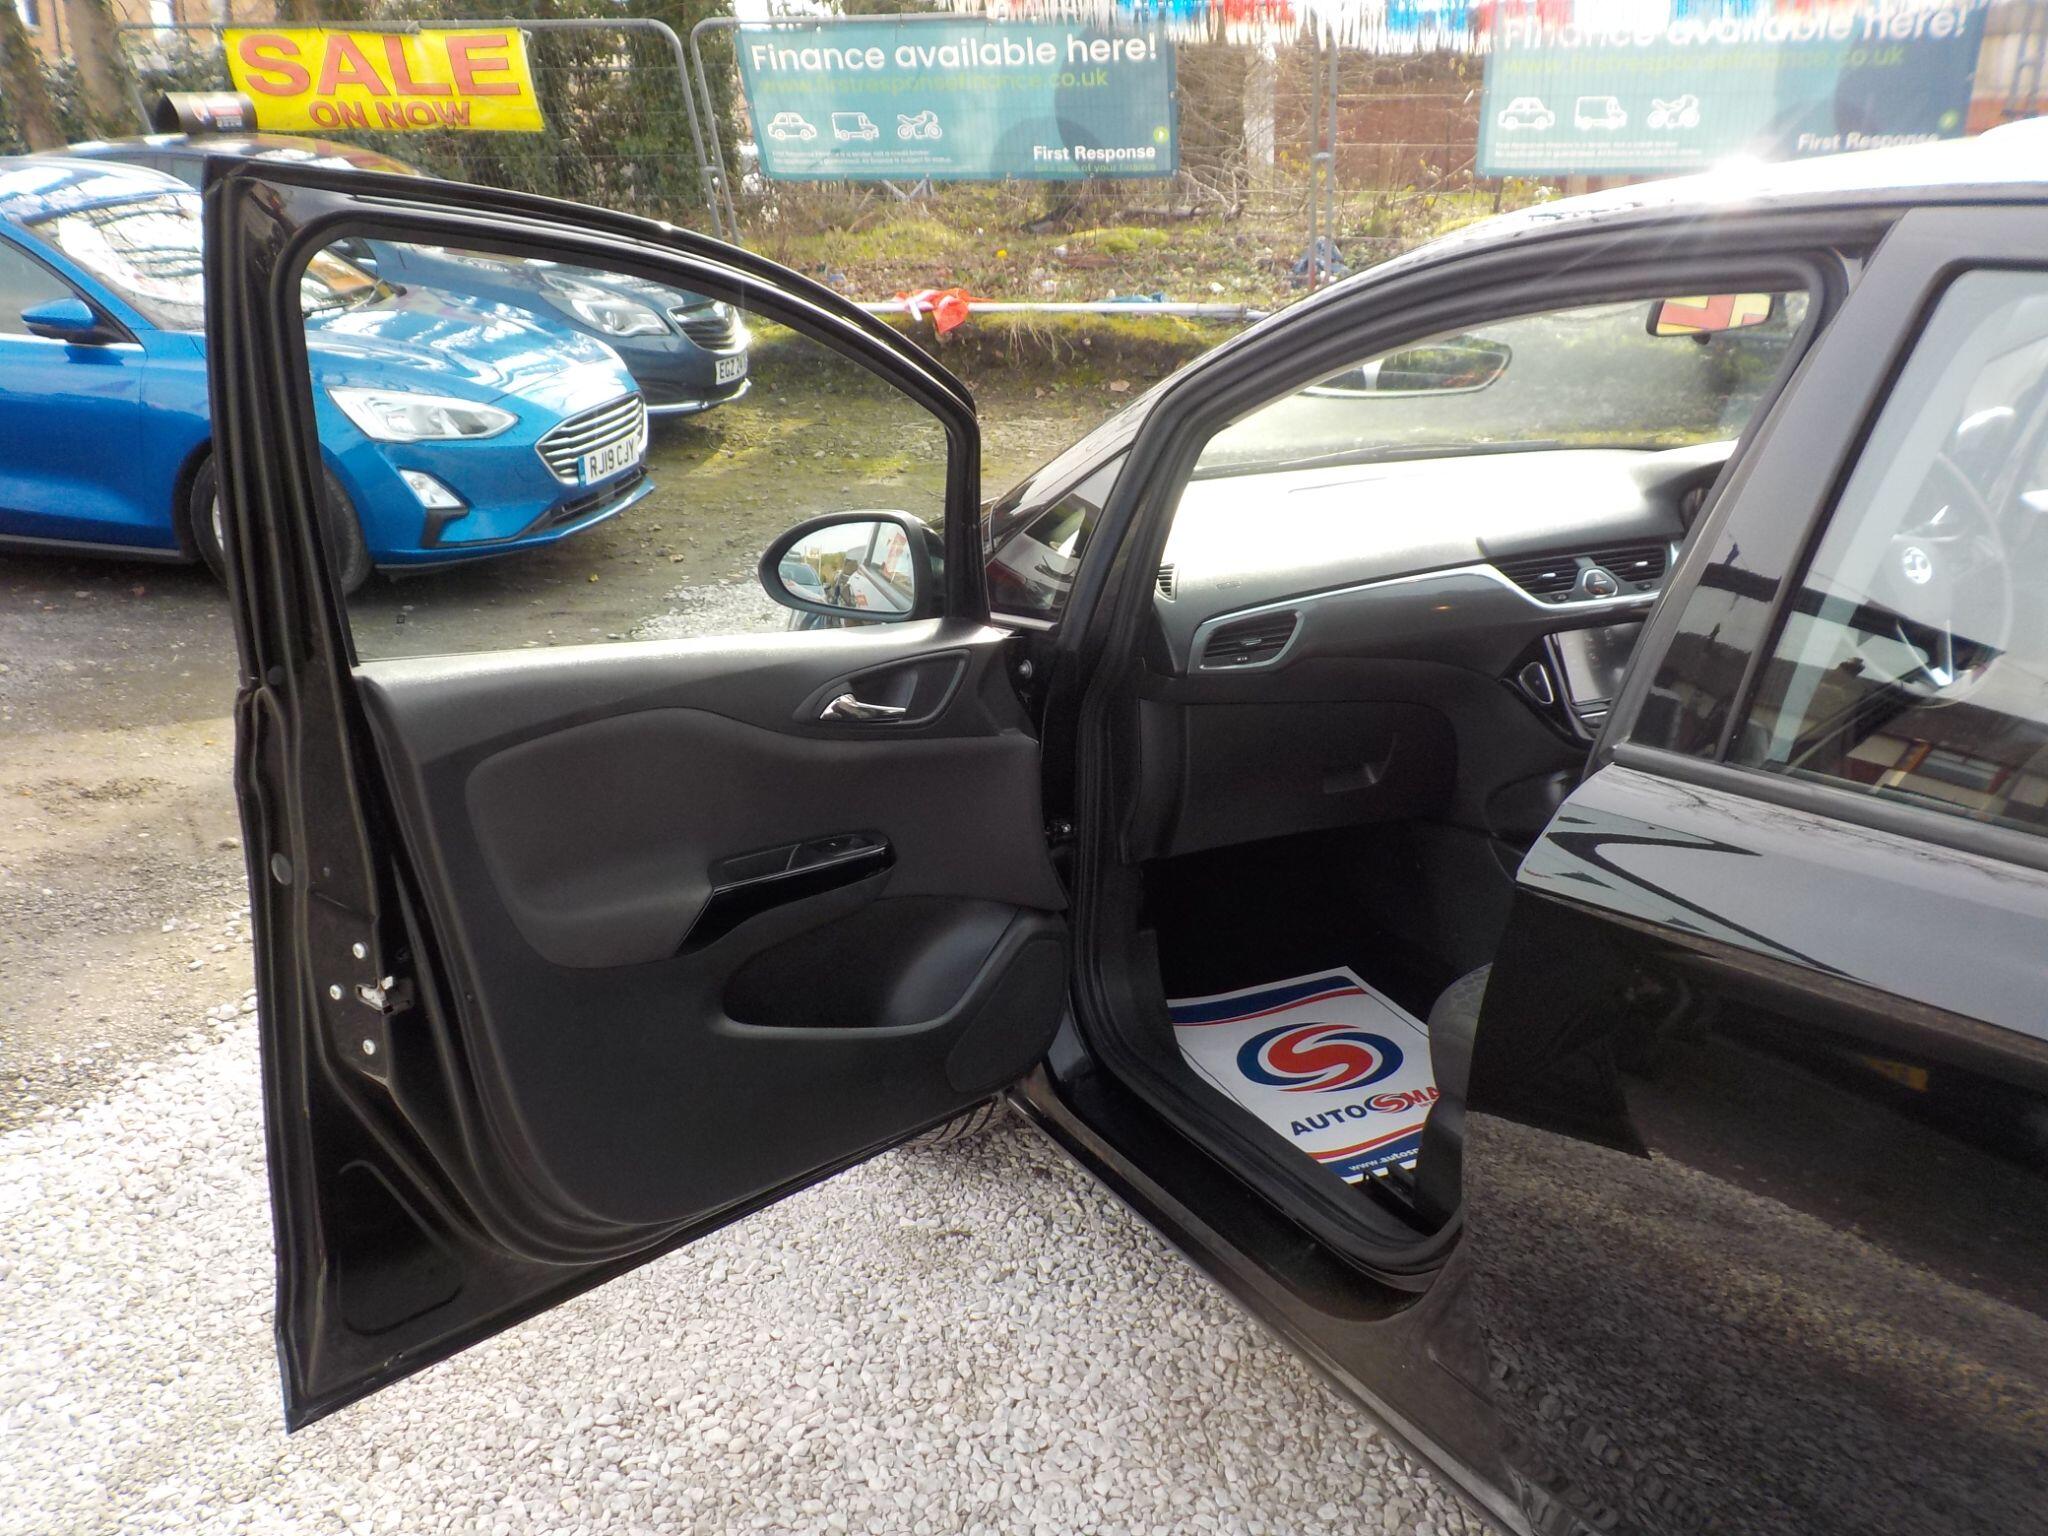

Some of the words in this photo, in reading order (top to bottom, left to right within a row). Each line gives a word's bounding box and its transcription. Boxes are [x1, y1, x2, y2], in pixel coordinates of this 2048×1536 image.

[239, 33, 521, 96] SALE
[751, 43, 886, 71] Finance
[895, 36, 1057, 68] available
[1067, 32, 1157, 63] here!
[309, 102, 370, 128] ON
[375, 101, 471, 128] NOW
[1033, 145, 1069, 161] First
[1074, 145, 1156, 162] Response
[1798, 133, 1840, 150] First
[589, 449, 614, 478] RJ19
[616, 438, 635, 466] CJY
